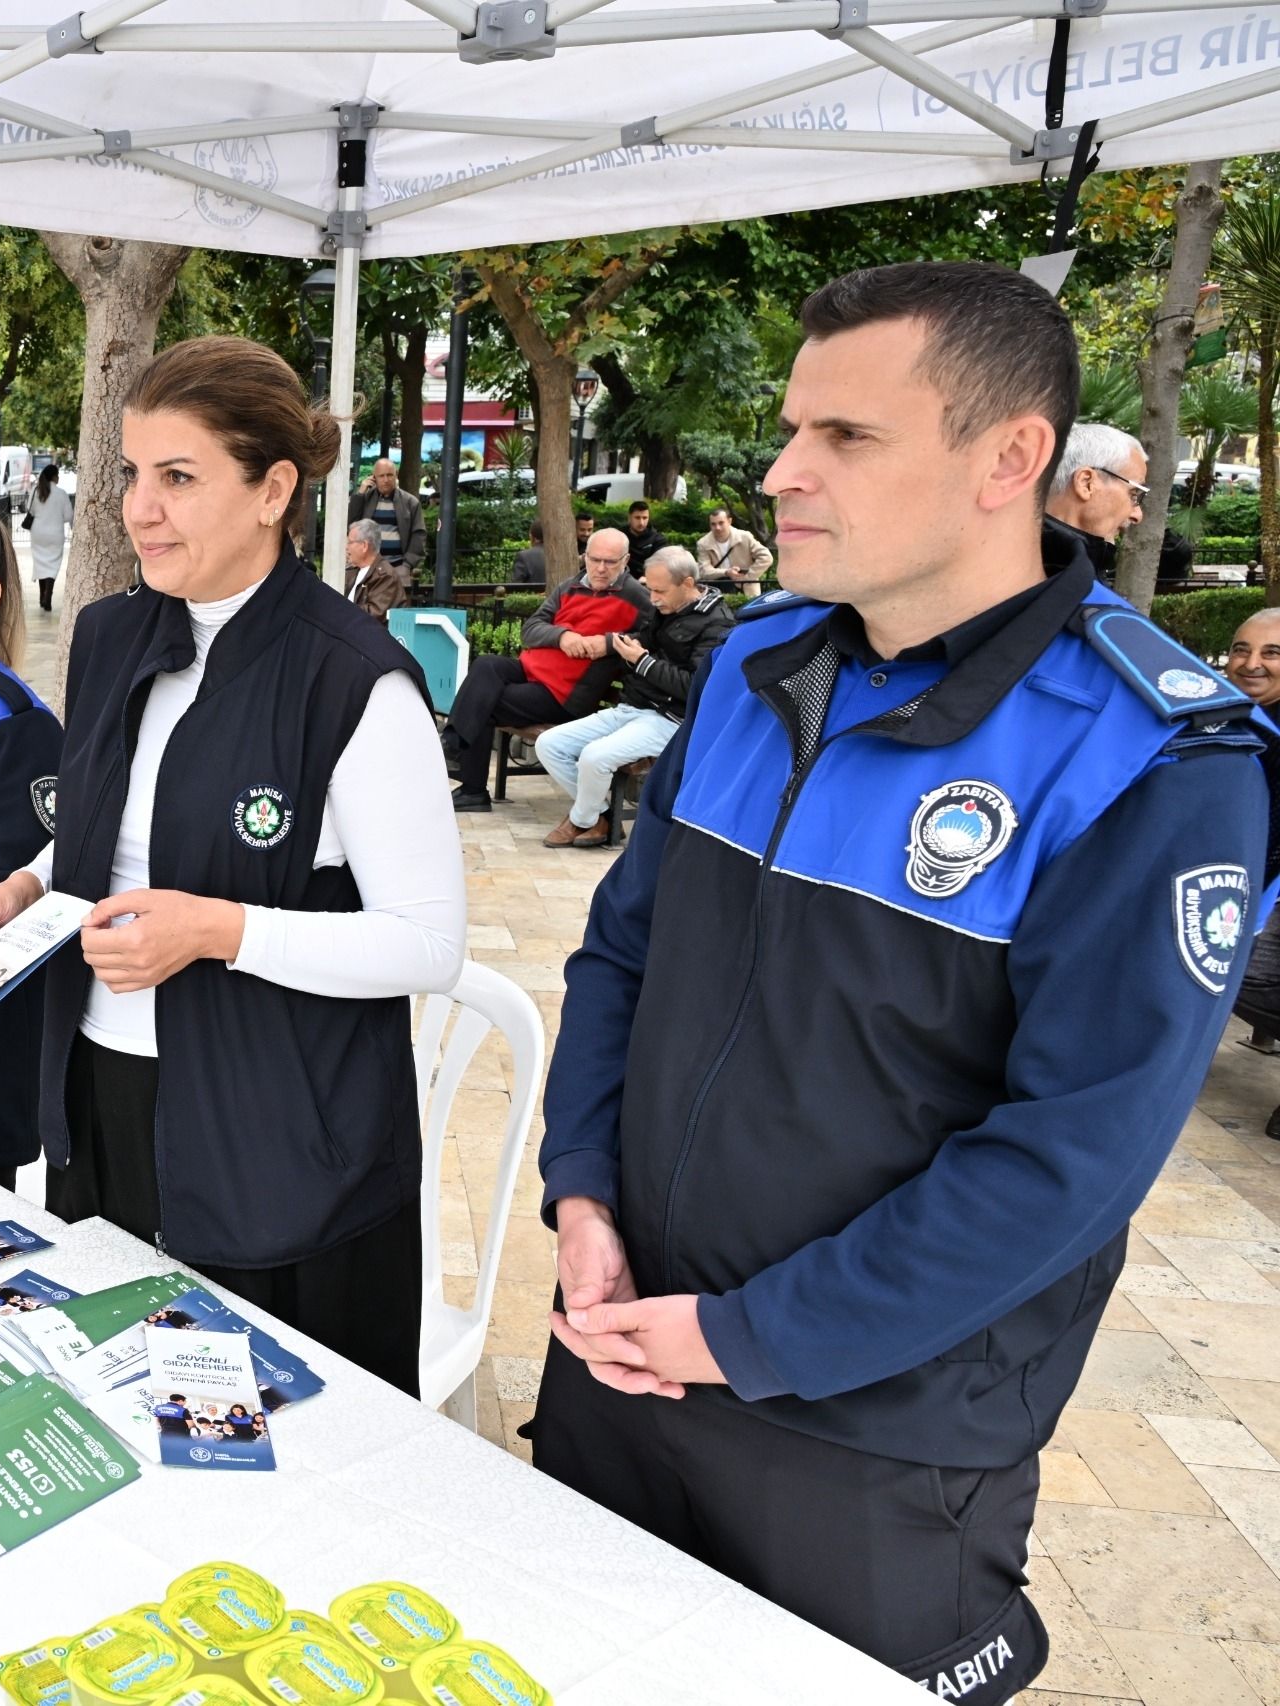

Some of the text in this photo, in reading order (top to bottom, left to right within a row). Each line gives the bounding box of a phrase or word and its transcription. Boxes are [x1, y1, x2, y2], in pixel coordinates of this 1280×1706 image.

[249, 787, 283, 802] MANİSA
[950, 786, 1002, 809] ZABITA
[163, 1360, 243, 1373] GIDA REHBERİ
[176, 1353, 228, 1364] GÜVENLİ
[6, 1448, 39, 1480] 153
[1, 1469, 34, 1507] GÜVENLE
